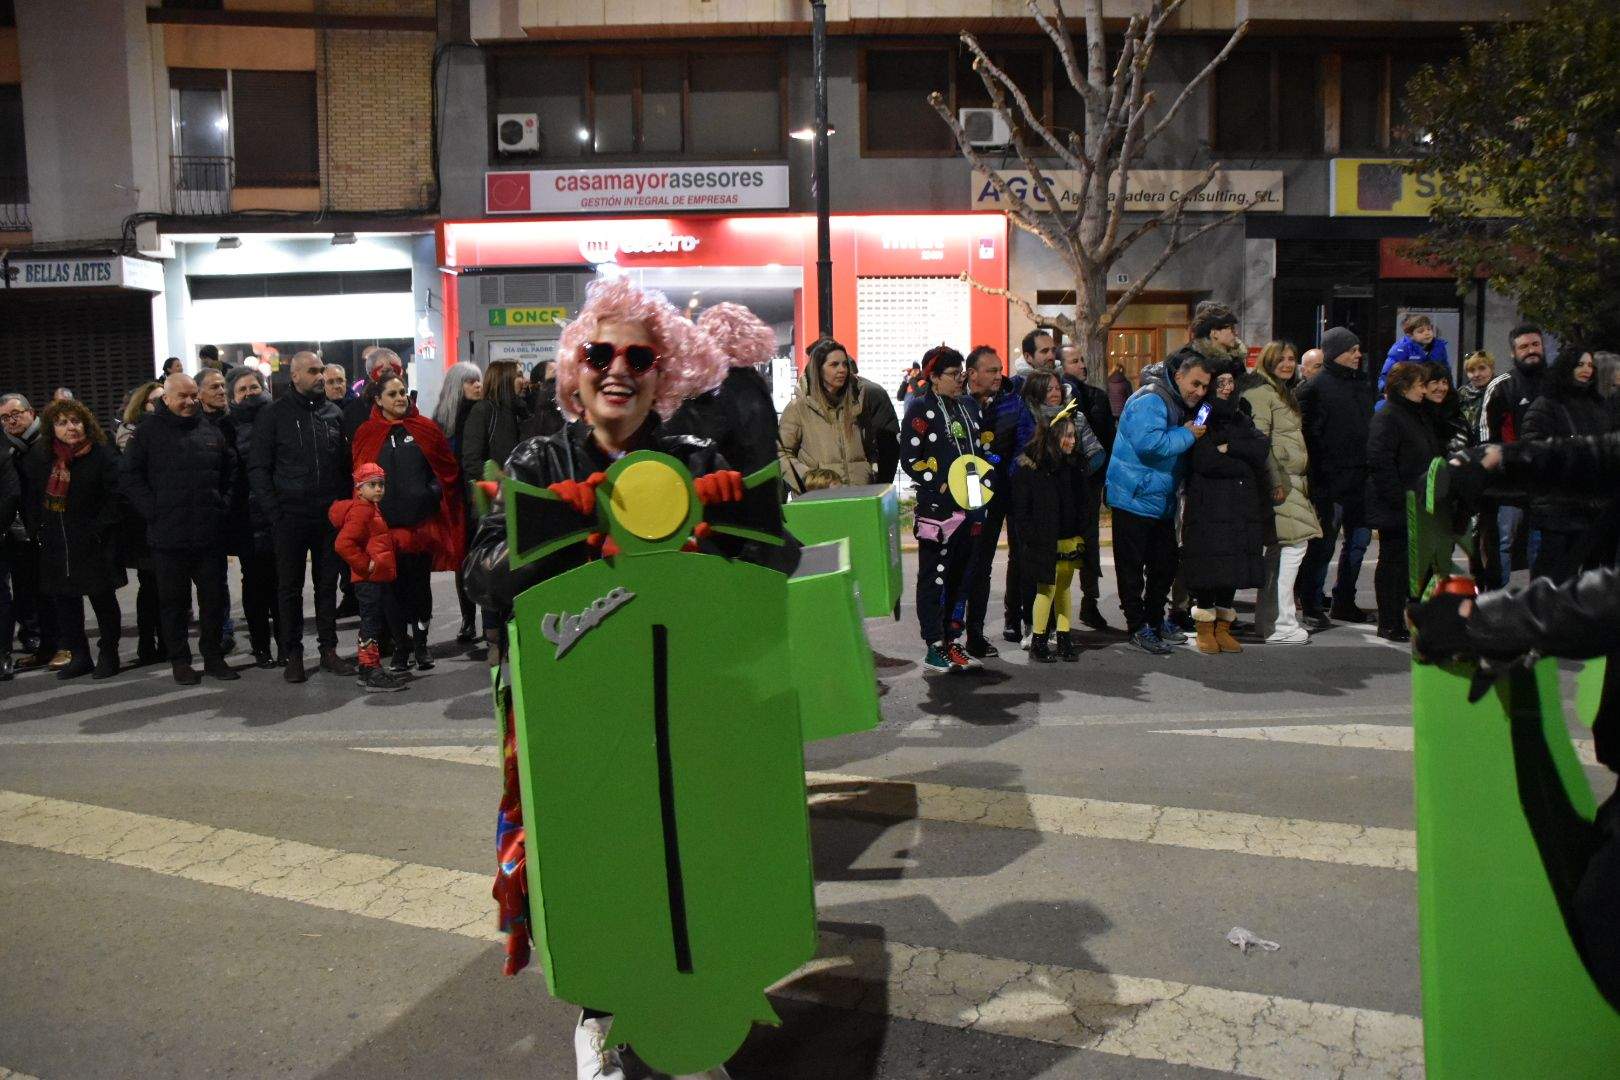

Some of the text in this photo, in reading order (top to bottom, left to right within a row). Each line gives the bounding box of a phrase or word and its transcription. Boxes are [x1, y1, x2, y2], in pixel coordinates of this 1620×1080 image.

[554, 170, 764, 195] casamayorasesores
[976, 176, 1055, 202] AGC
[580, 194, 739, 208] GESTIÓN INTEGRAL DE EMPRESAS
[1169, 189, 1249, 205] Cnsulting,
[25, 262, 112, 283] BELLAS ARTES
[512, 310, 561, 323] ONCE
